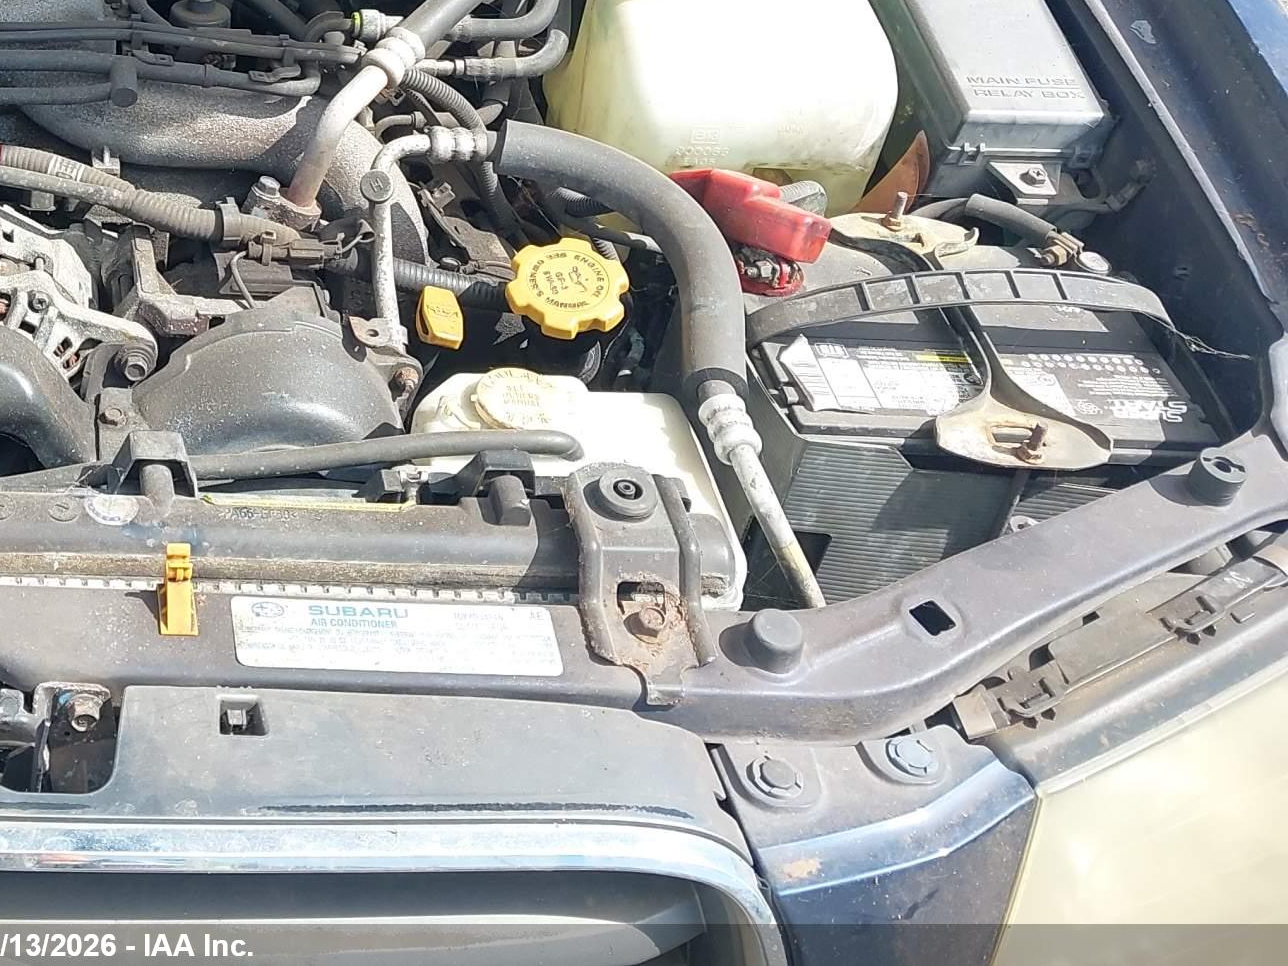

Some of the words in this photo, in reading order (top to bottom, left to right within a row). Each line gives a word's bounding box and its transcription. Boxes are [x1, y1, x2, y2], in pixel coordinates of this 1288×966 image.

[966, 75, 1021, 85] MAIN
[1024, 76, 1076, 86] FUSE
[973, 88, 1034, 99] RELAY
[1042, 90, 1086, 99] BOX
[369, 177, 384, 194] H
[573, 254, 605, 283] ENGINE
[592, 284, 605, 298] OIL
[308, 605, 409, 619] SUBARU
[311, 618, 327, 627] AIR
[329, 618, 397, 628] CONDITIONER
